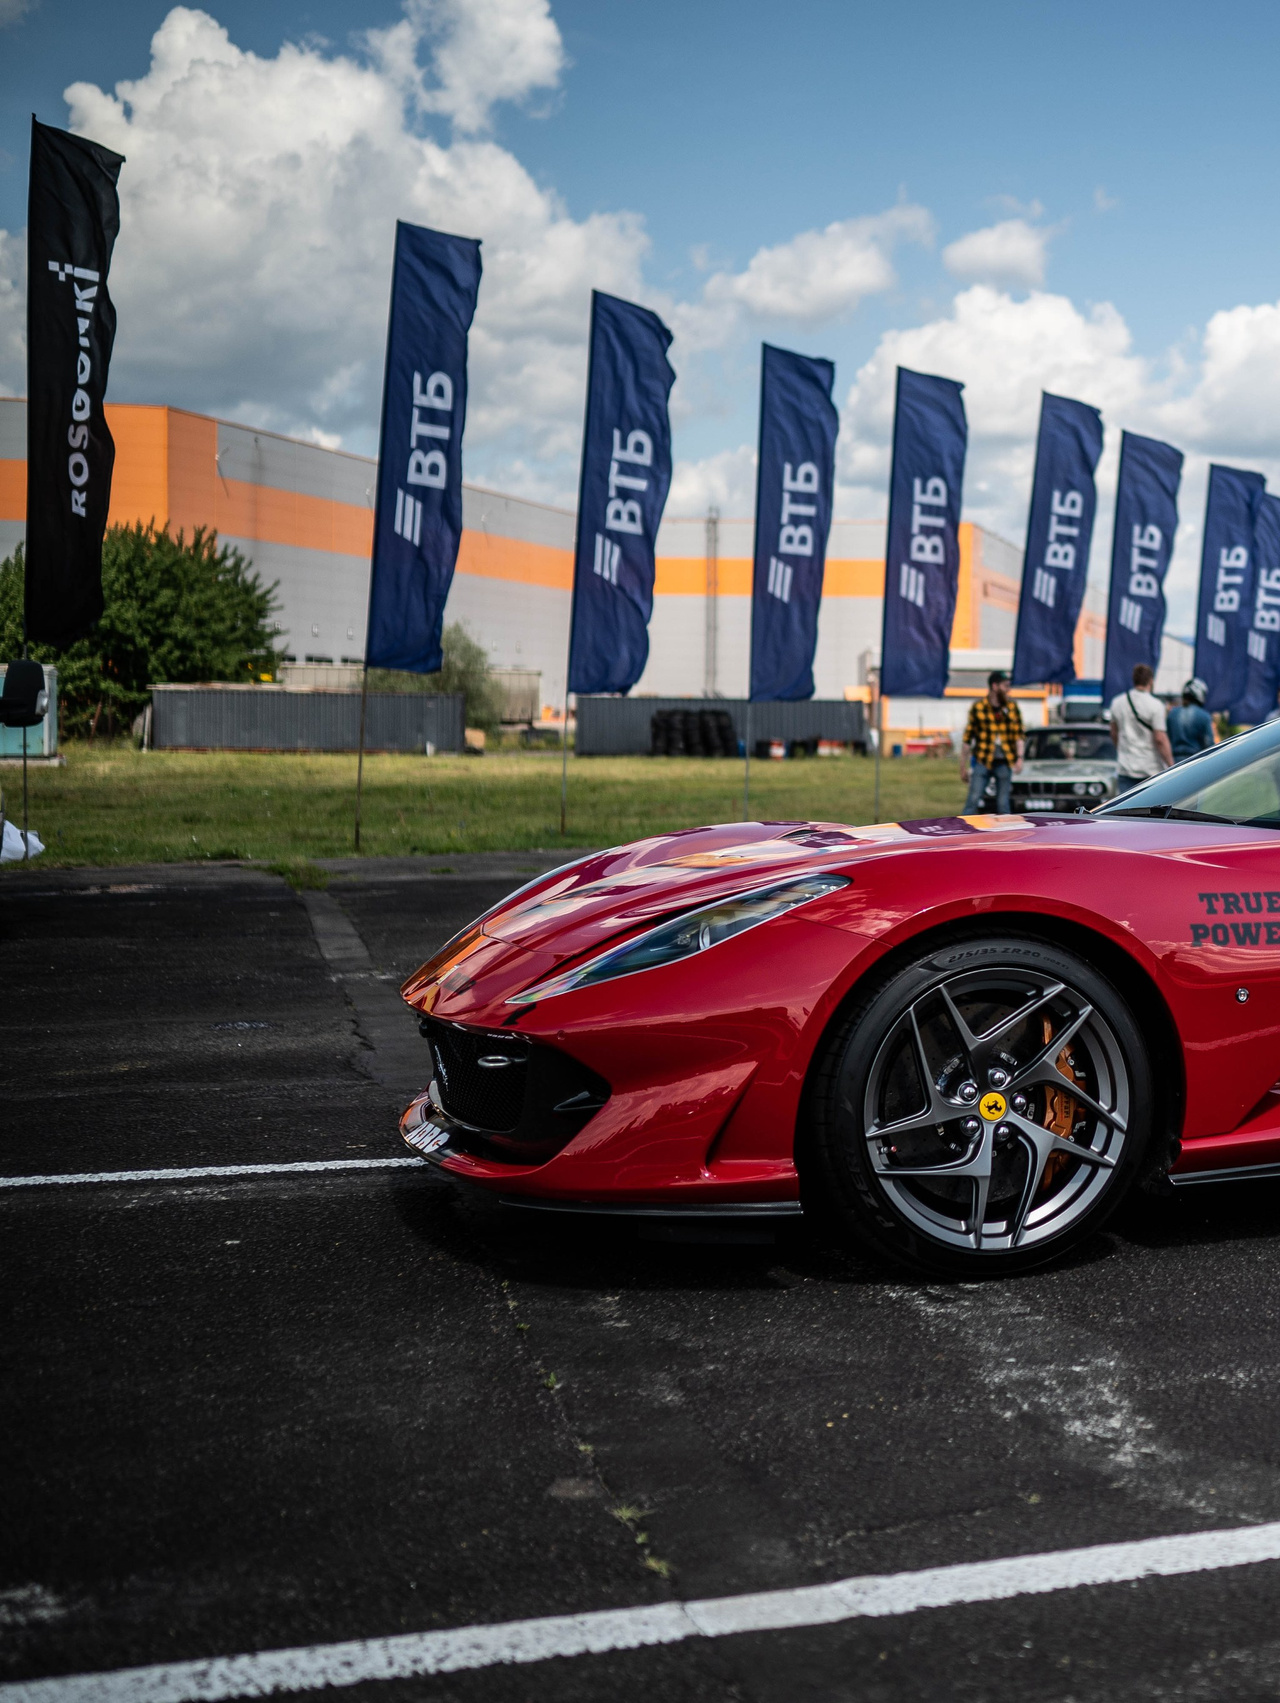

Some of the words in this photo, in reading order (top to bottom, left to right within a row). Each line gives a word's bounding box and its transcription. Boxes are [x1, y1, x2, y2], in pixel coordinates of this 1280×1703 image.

[68, 266, 101, 518] ROSGONKI
[407, 371, 454, 489] ВТБ
[605, 428, 654, 536] ВТБ
[779, 461, 820, 558] ВТБ
[911, 476, 949, 566] ВТБ
[1044, 489, 1083, 571] ВТБ
[1129, 523, 1163, 599] ВТБ
[1214, 545, 1248, 614] ВТБ
[948, 947, 997, 964] 275/35
[1001, 947, 1041, 958] ZR20
